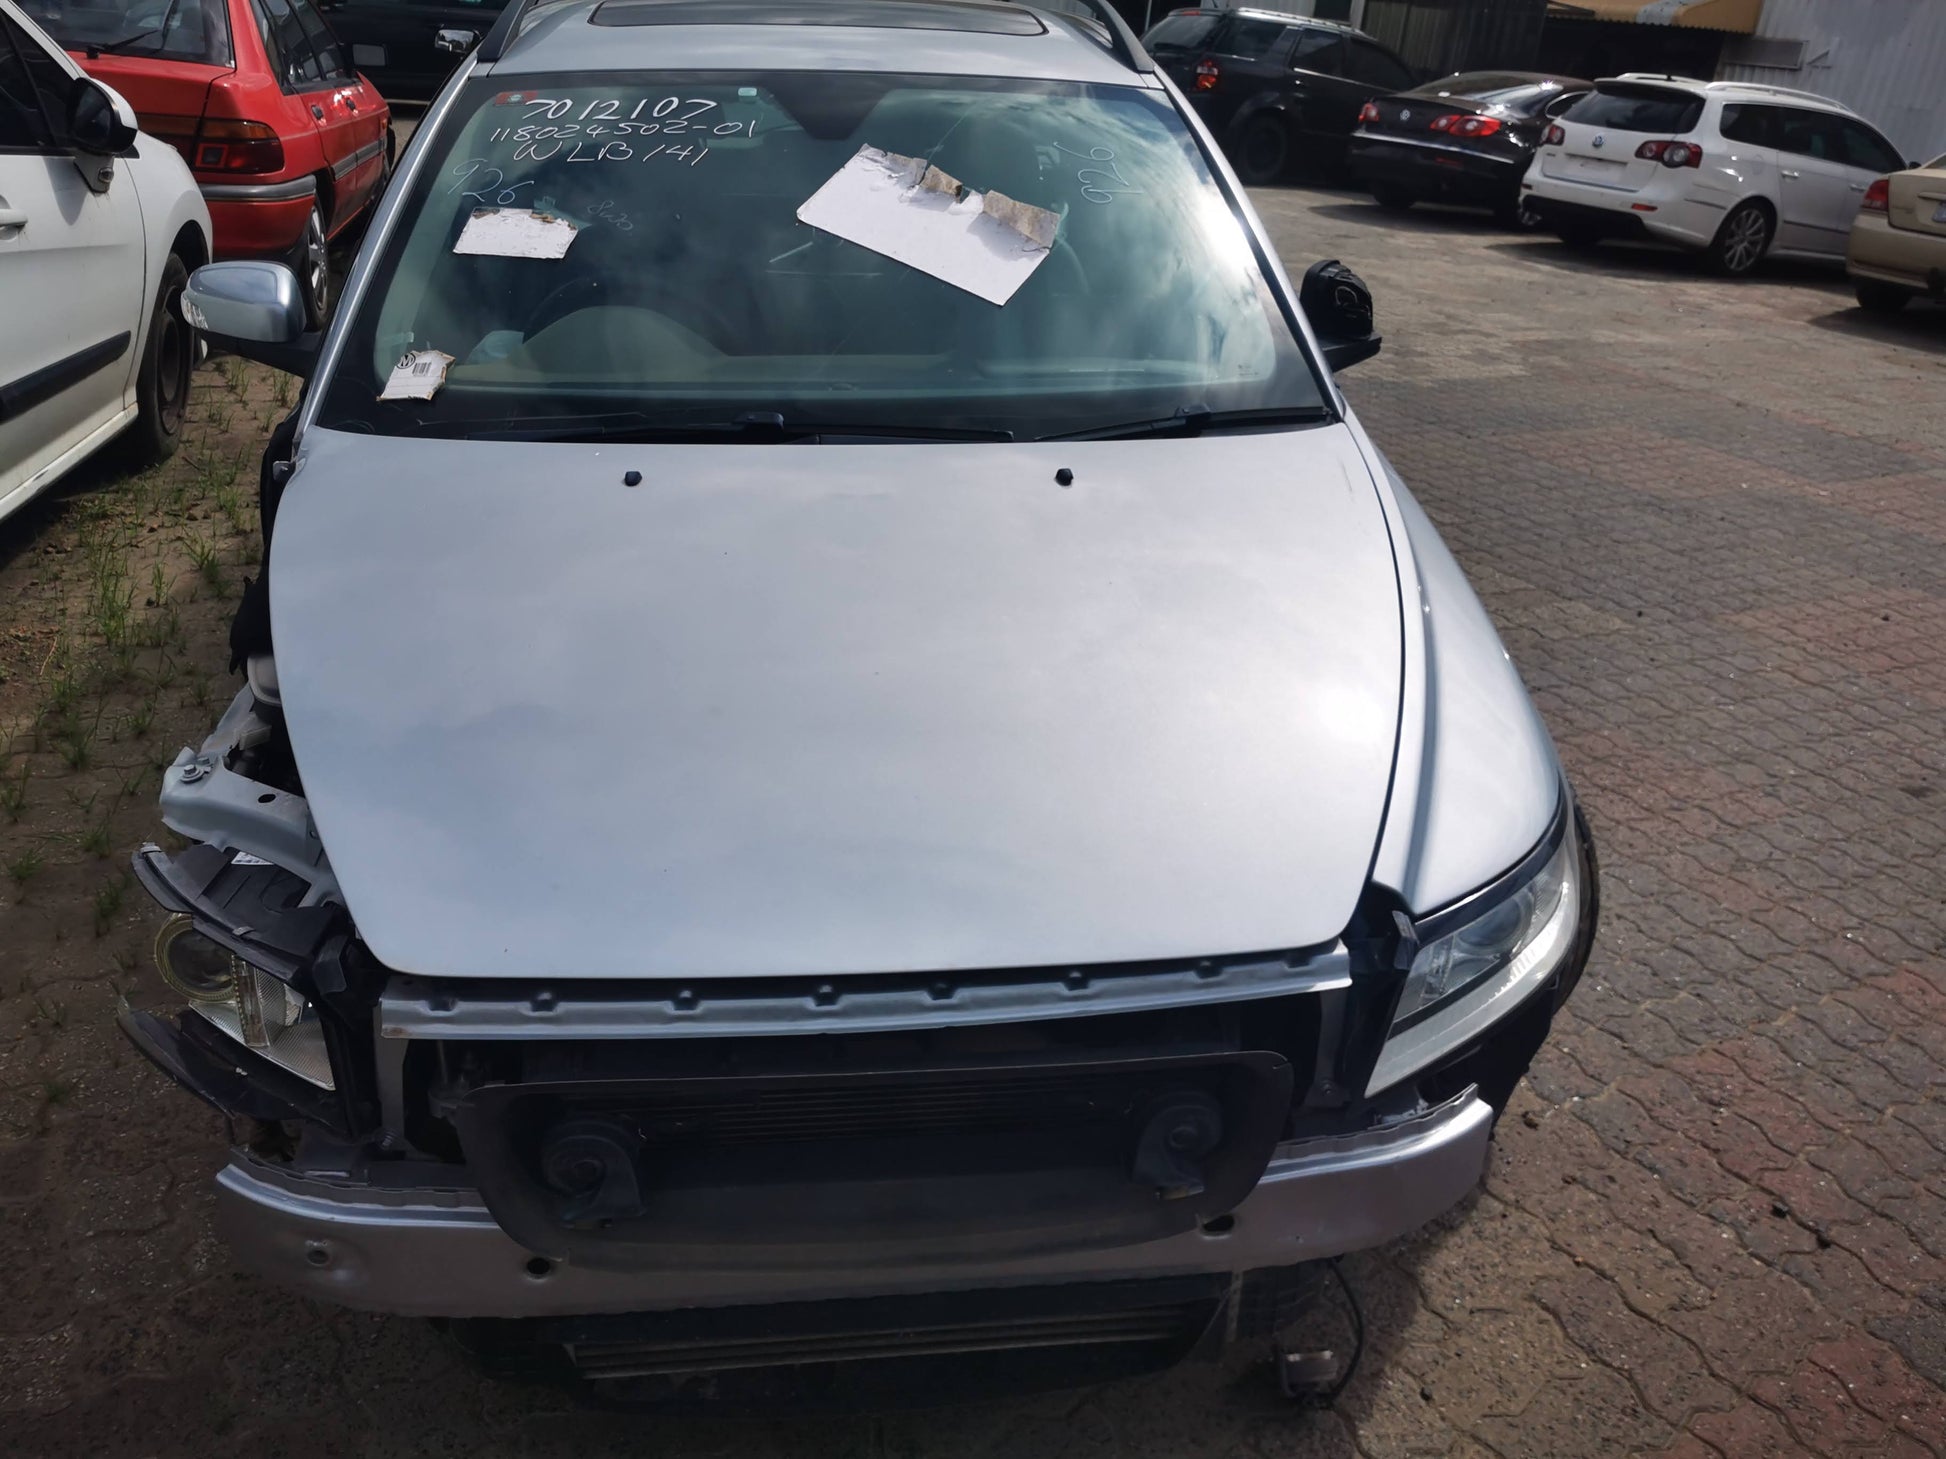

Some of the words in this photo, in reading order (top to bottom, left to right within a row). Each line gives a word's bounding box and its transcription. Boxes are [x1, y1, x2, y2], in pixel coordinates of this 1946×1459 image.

[522, 98, 718, 120] 7012107
[490, 120, 756, 142] 118024502-01
[448, 159, 535, 204] 926
